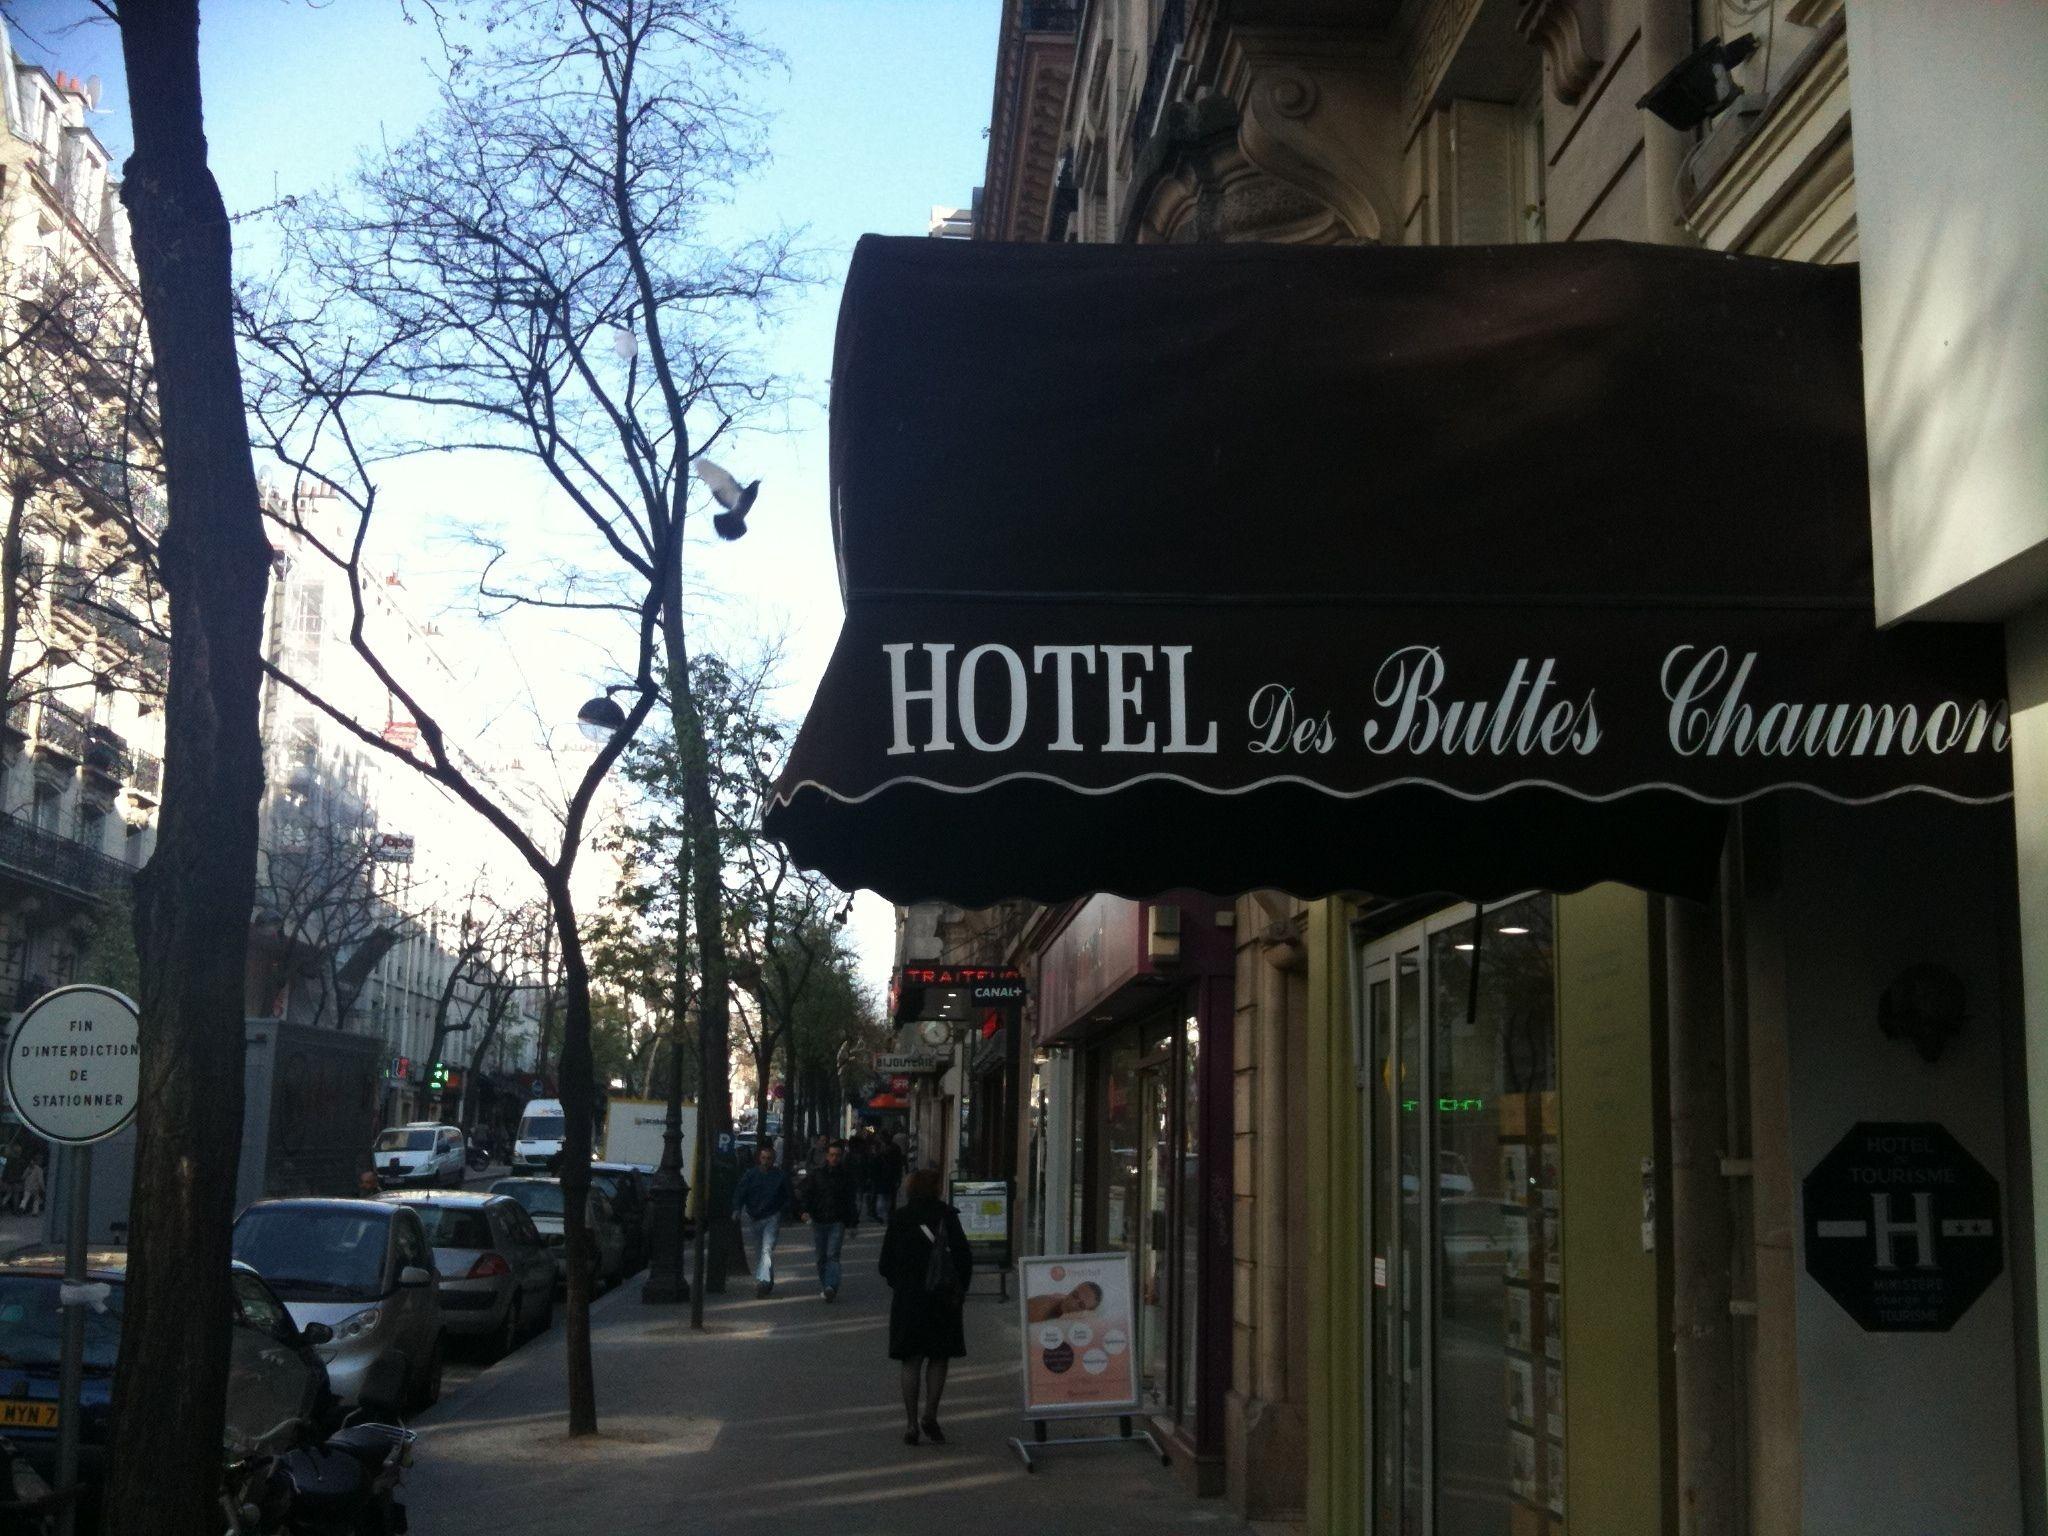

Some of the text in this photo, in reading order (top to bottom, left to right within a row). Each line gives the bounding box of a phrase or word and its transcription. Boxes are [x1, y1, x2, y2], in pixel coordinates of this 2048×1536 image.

[882, 642, 1218, 756] HOTEL
[1247, 683, 1337, 755] Des
[1363, 645, 1603, 756] Buttes
[974, 987, 1023, 998] CANAL+
[70, 1020, 93, 1032] FIN
[21, 1044, 139, 1058] D'INTERDICTION
[70, 1070, 88, 1081] DE
[32, 1094, 124, 1107] STATIONNER
[1865, 1136, 1936, 1153] HOTEL
[1848, 1167, 1956, 1184] TOURISME
[1870, 1192, 1942, 1271] H
